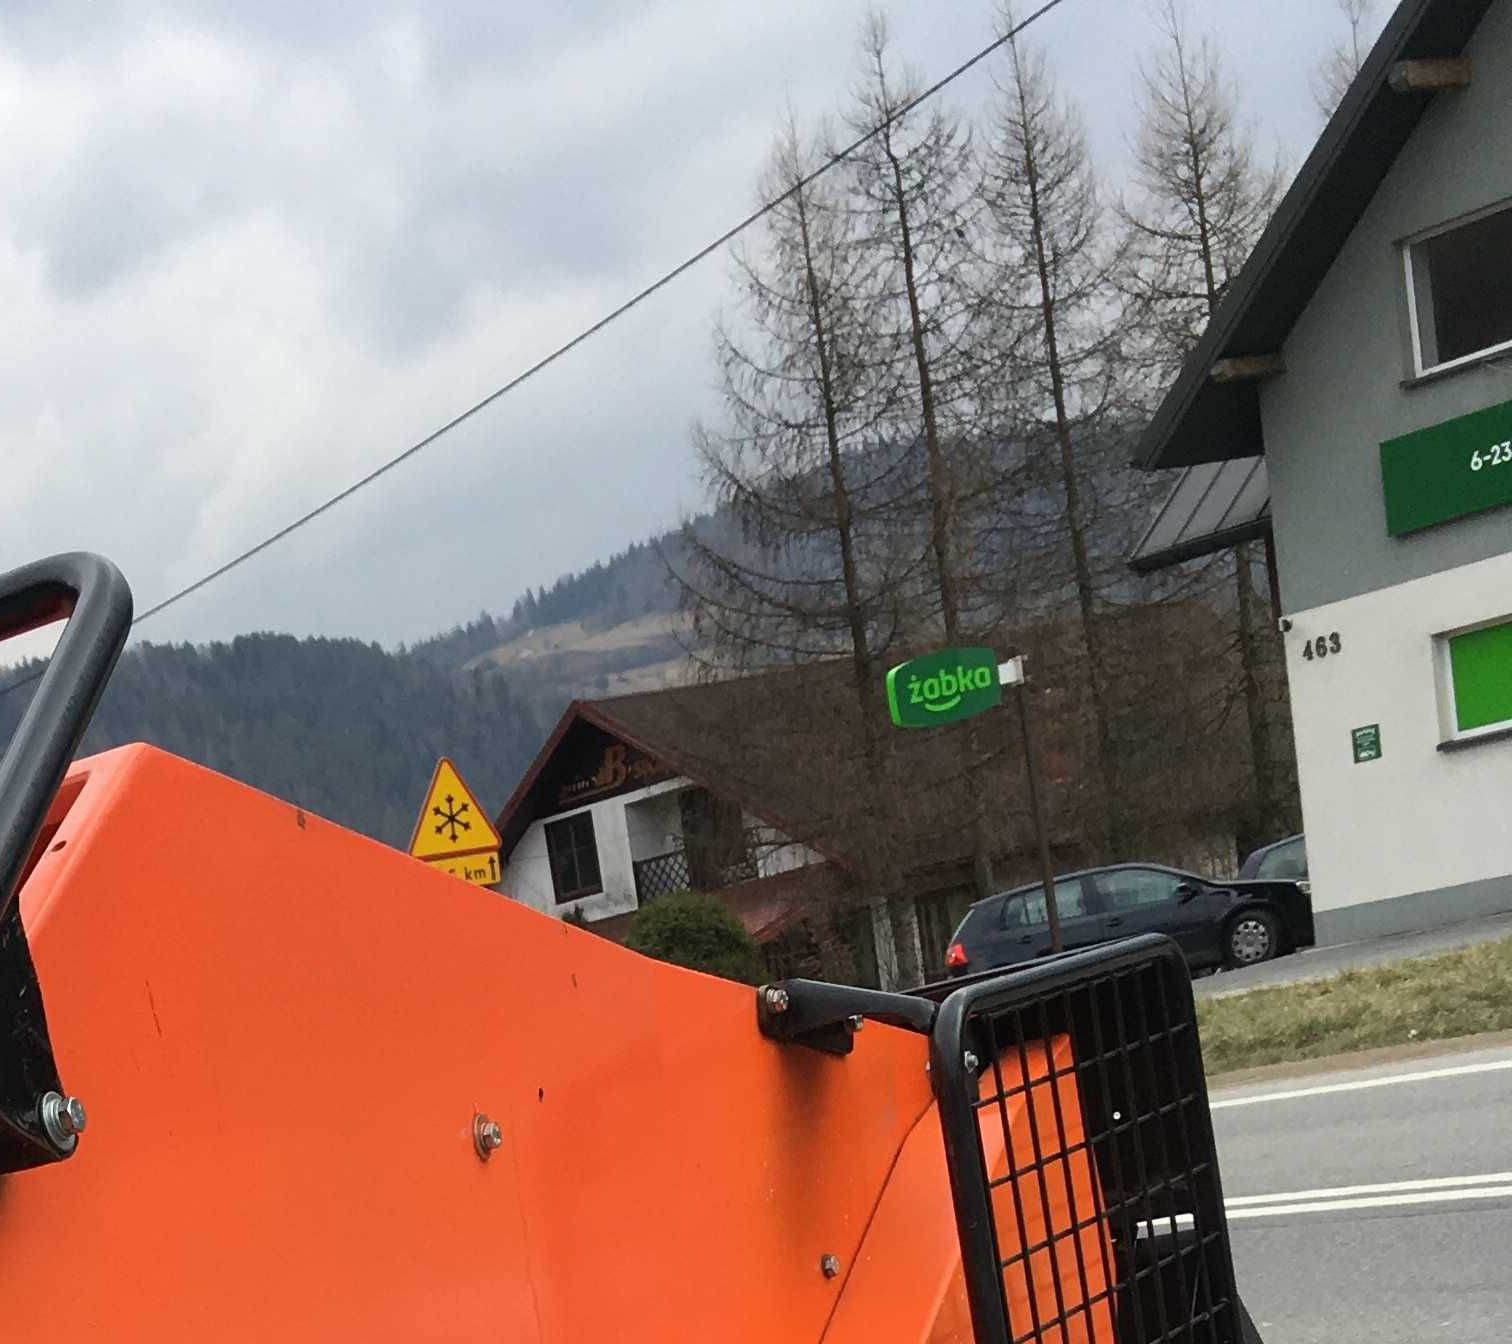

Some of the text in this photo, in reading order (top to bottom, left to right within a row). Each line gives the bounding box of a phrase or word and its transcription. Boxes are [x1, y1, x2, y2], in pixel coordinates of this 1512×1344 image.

[1470, 440, 1512, 471] 6-23
[1302, 631, 1342, 661] 463
[907, 665, 991, 704] żabka
[464, 866, 487, 881] km
